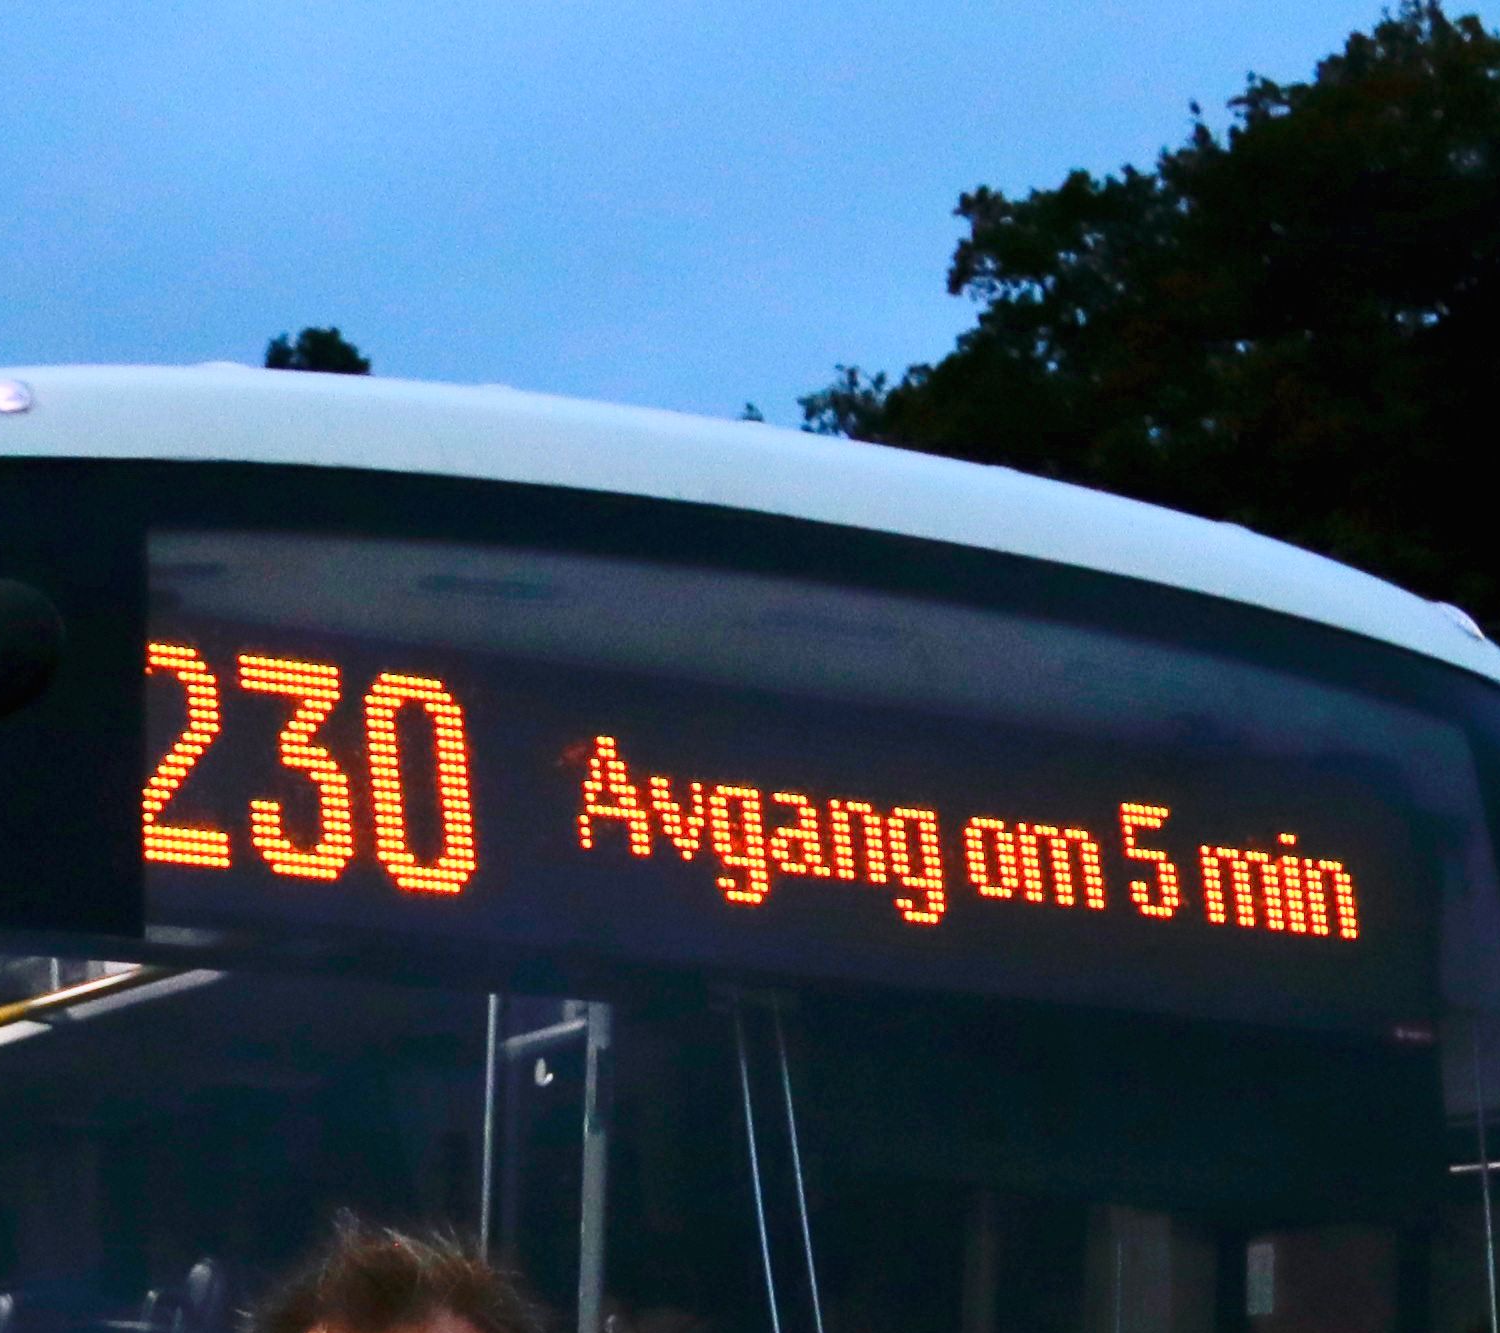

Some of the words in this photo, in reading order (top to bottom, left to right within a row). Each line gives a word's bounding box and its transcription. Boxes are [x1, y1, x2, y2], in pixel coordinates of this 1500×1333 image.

[141, 642, 478, 896] 230
[576, 736, 948, 925] Avgang
[962, 816, 1106, 911] om
[1119, 802, 1183, 919] 5
[1198, 833, 1359, 939] min
